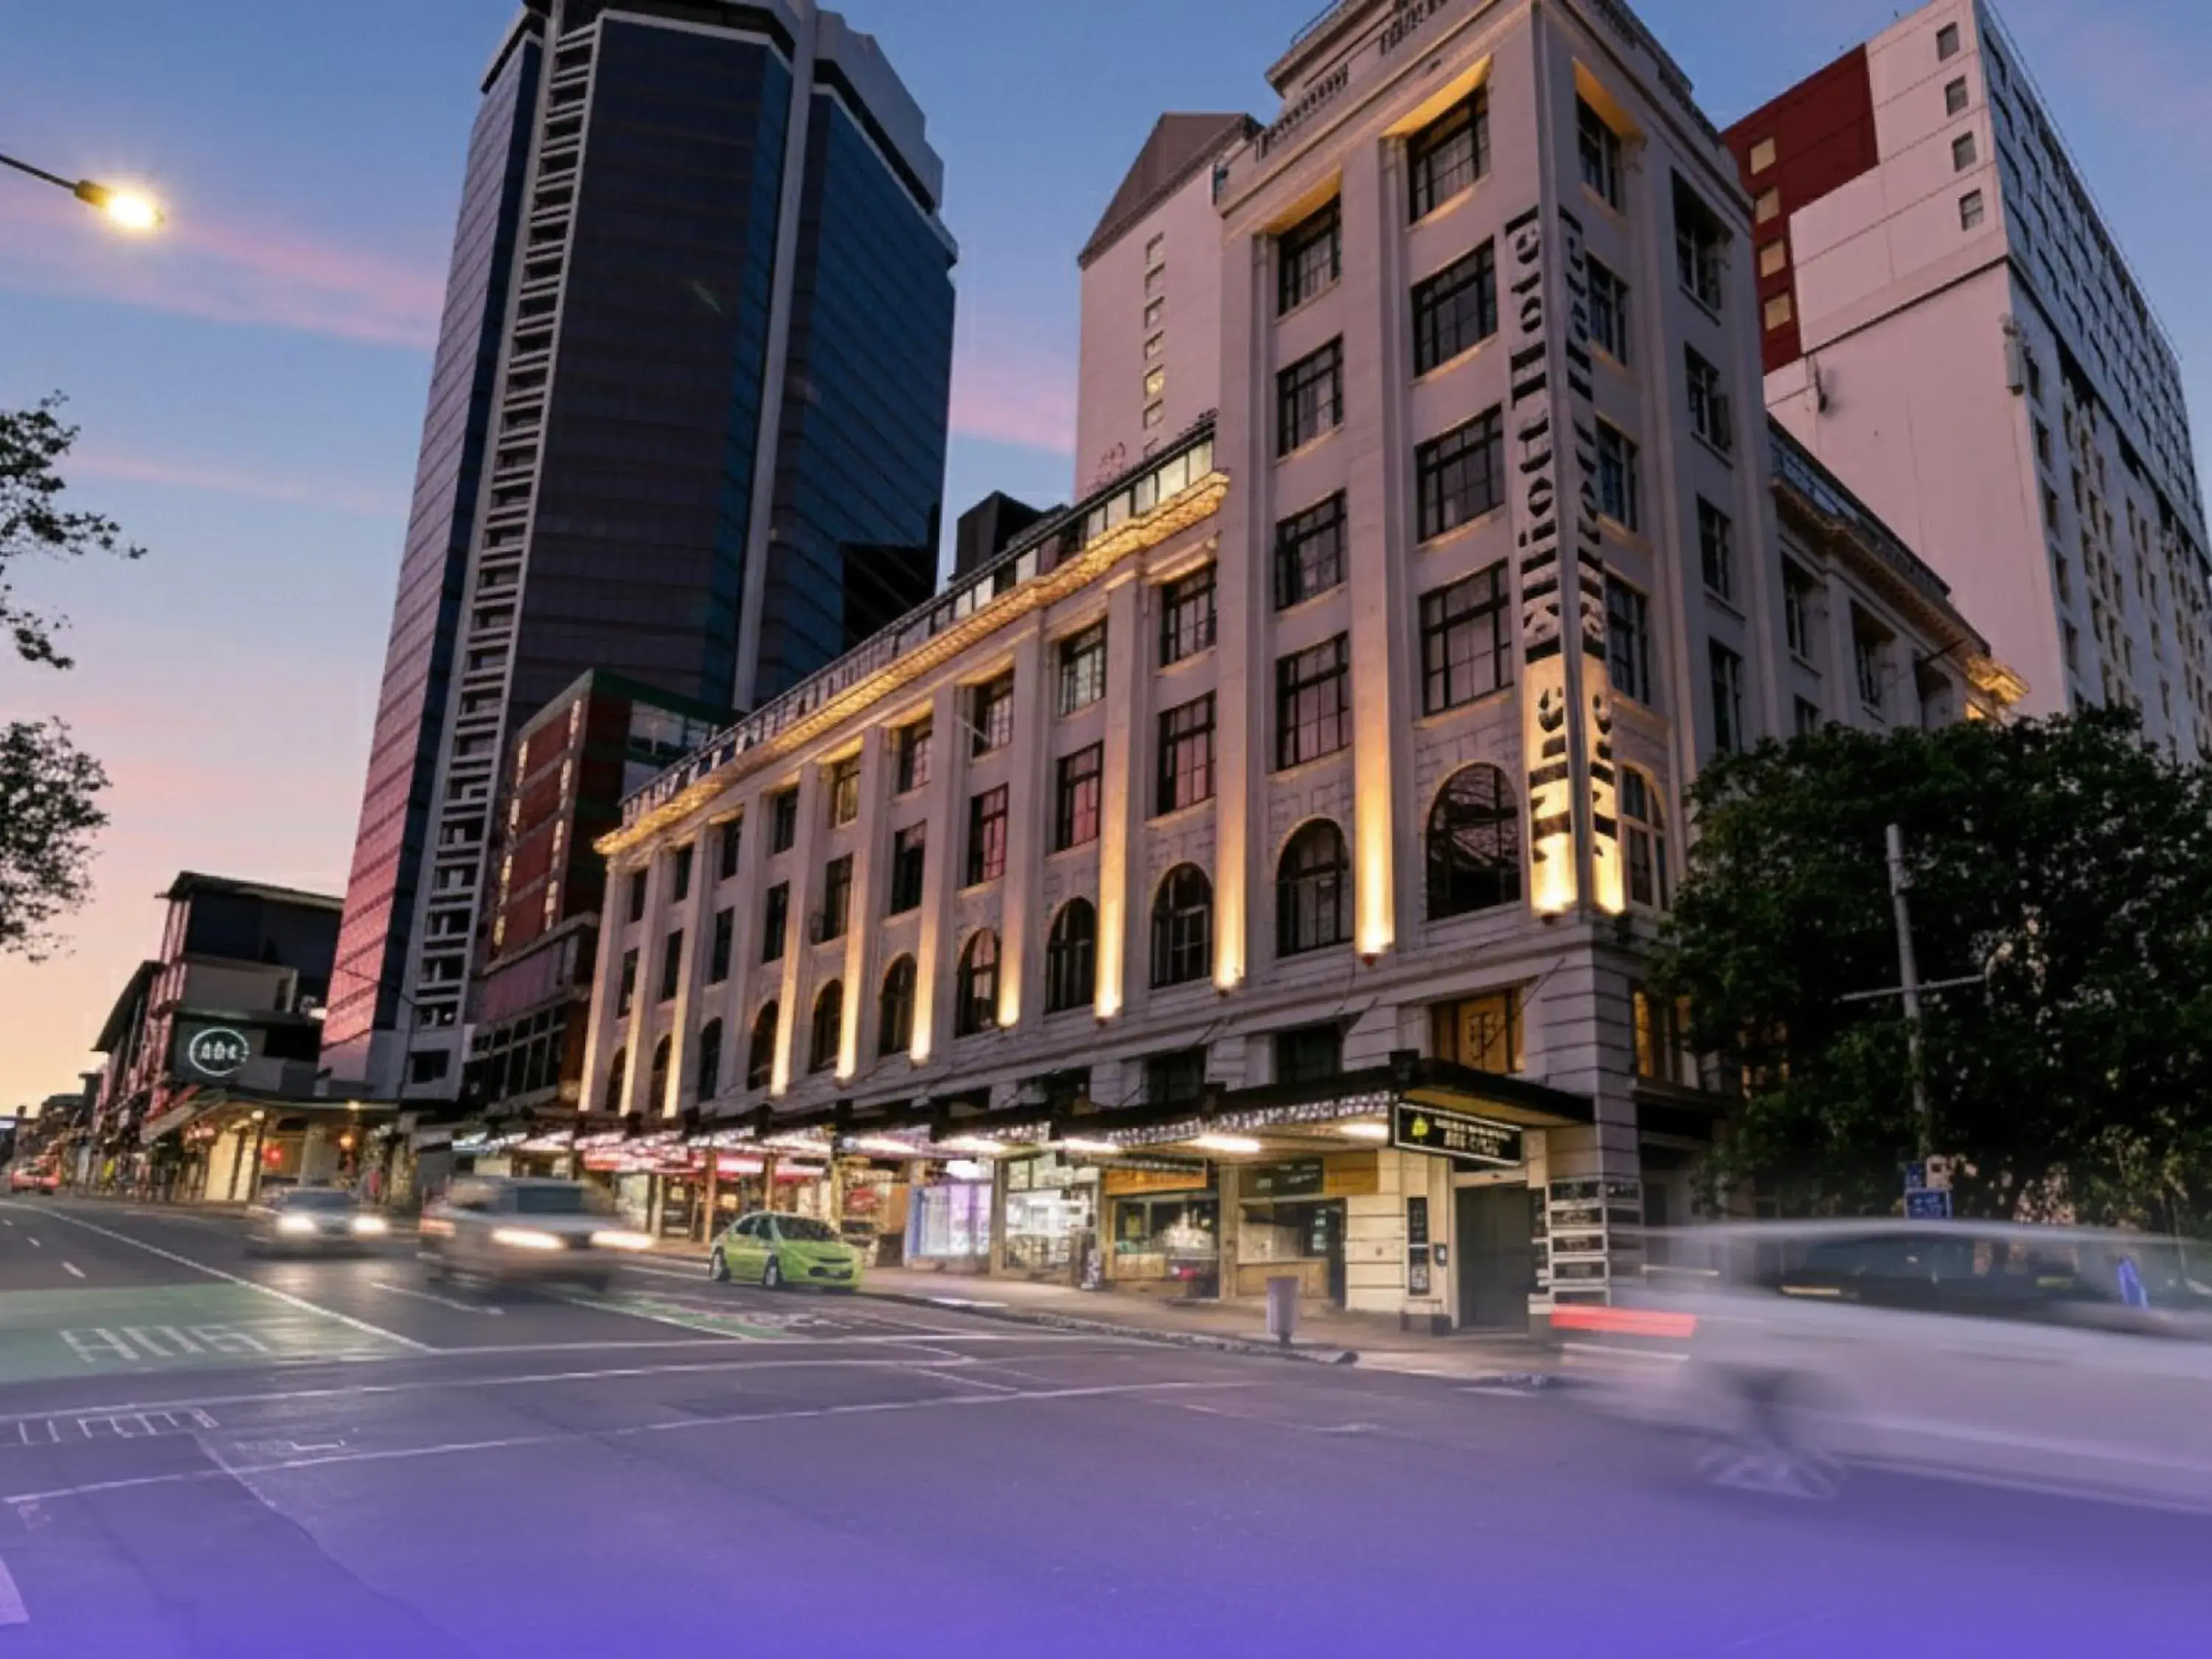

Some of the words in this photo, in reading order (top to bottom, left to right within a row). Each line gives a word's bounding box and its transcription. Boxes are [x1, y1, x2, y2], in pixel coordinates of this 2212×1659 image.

[1504, 206, 1547, 409] Hotel
[1558, 204, 1593, 402] Hotel
[1517, 414, 1563, 664] Elliott
[1572, 417, 1607, 661] Elliott
[1528, 687, 1572, 862] The
[1589, 692, 1618, 858] The
